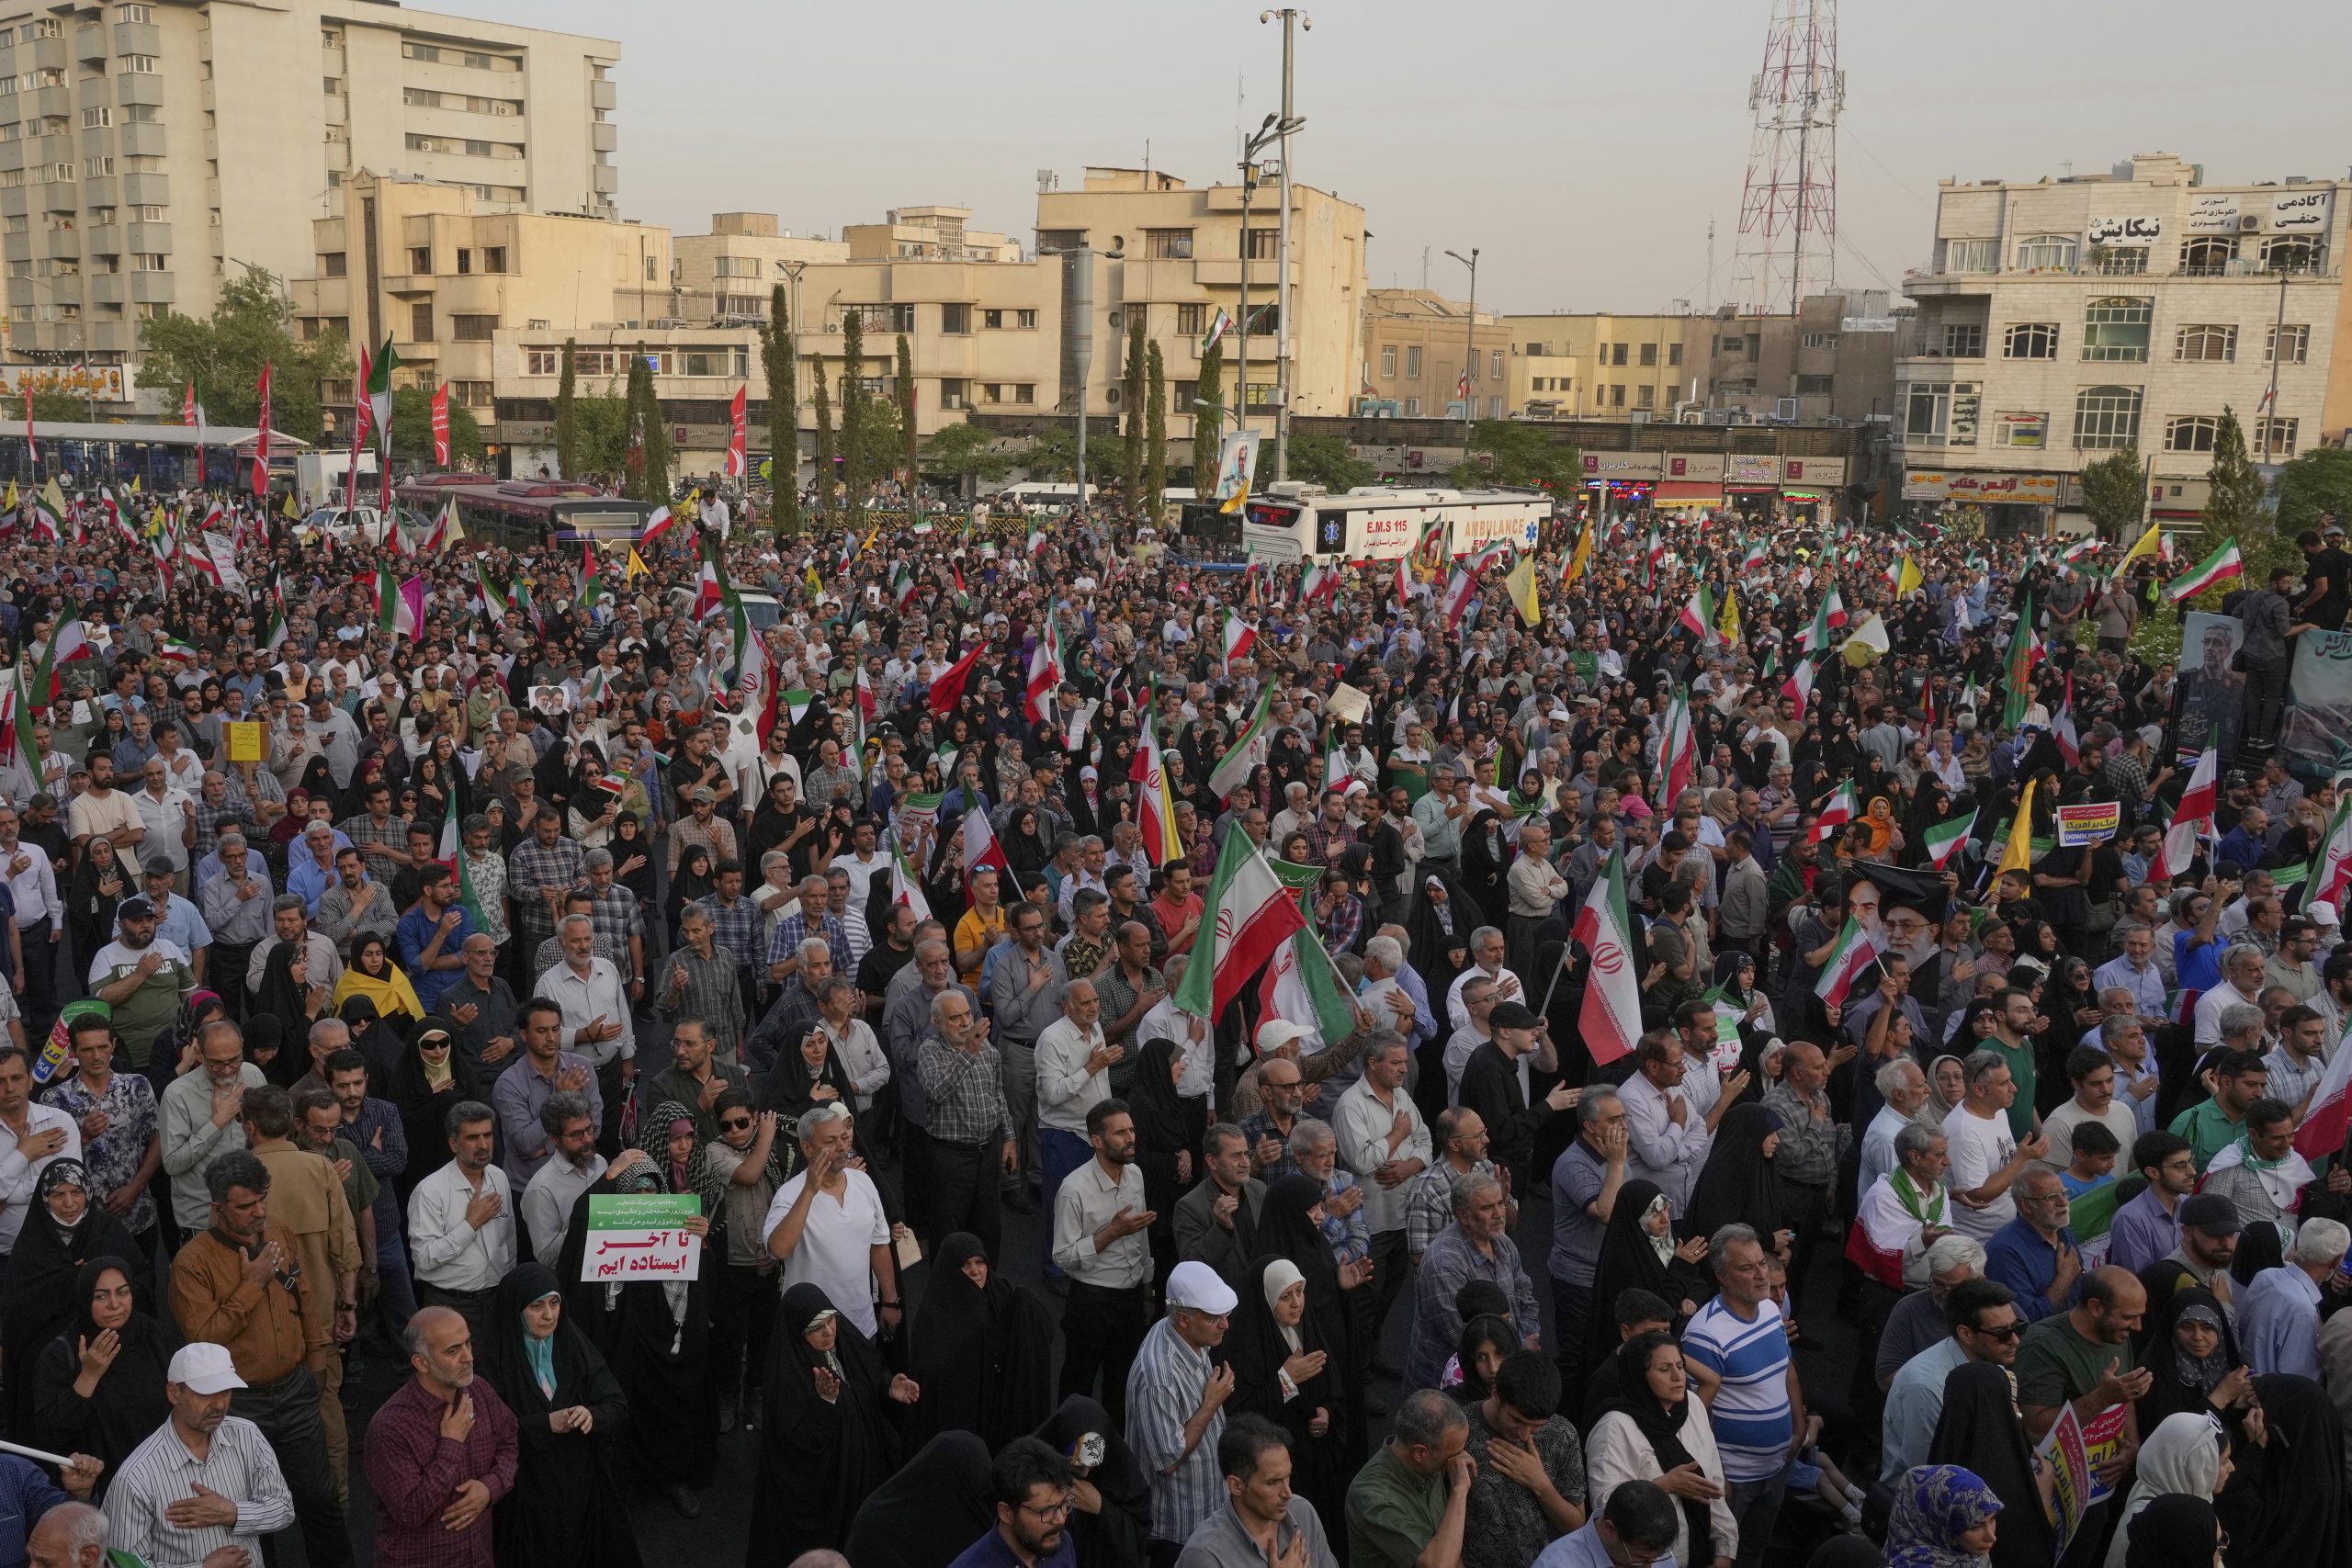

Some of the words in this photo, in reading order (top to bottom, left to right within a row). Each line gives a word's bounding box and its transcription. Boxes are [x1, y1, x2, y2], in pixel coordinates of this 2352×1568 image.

[2200, 197, 2229, 206] آموزش
[2277, 193, 2329, 210] آکادمی
[2208, 209, 2236, 217] الگوسازی
[2275, 212, 2321, 228] حنفی
[2088, 217, 2160, 244] نیکایش
[1948, 478, 1979, 491] کتاب
[1981, 478, 2018, 492] آژانس
[1254, 505, 1290, 515] AMBULANCE
[1366, 521, 1391, 534] E.M.S
[1394, 520, 1408, 532] 115
[1464, 518, 1525, 537] AMBULANCE
[2065, 832, 2087, 840] DOWN
[596, 1232, 671, 1255] آخر
[678, 1231, 691, 1247] تا
[597, 1255, 626, 1278] ایم
[629, 1254, 687, 1274] ایستاده
